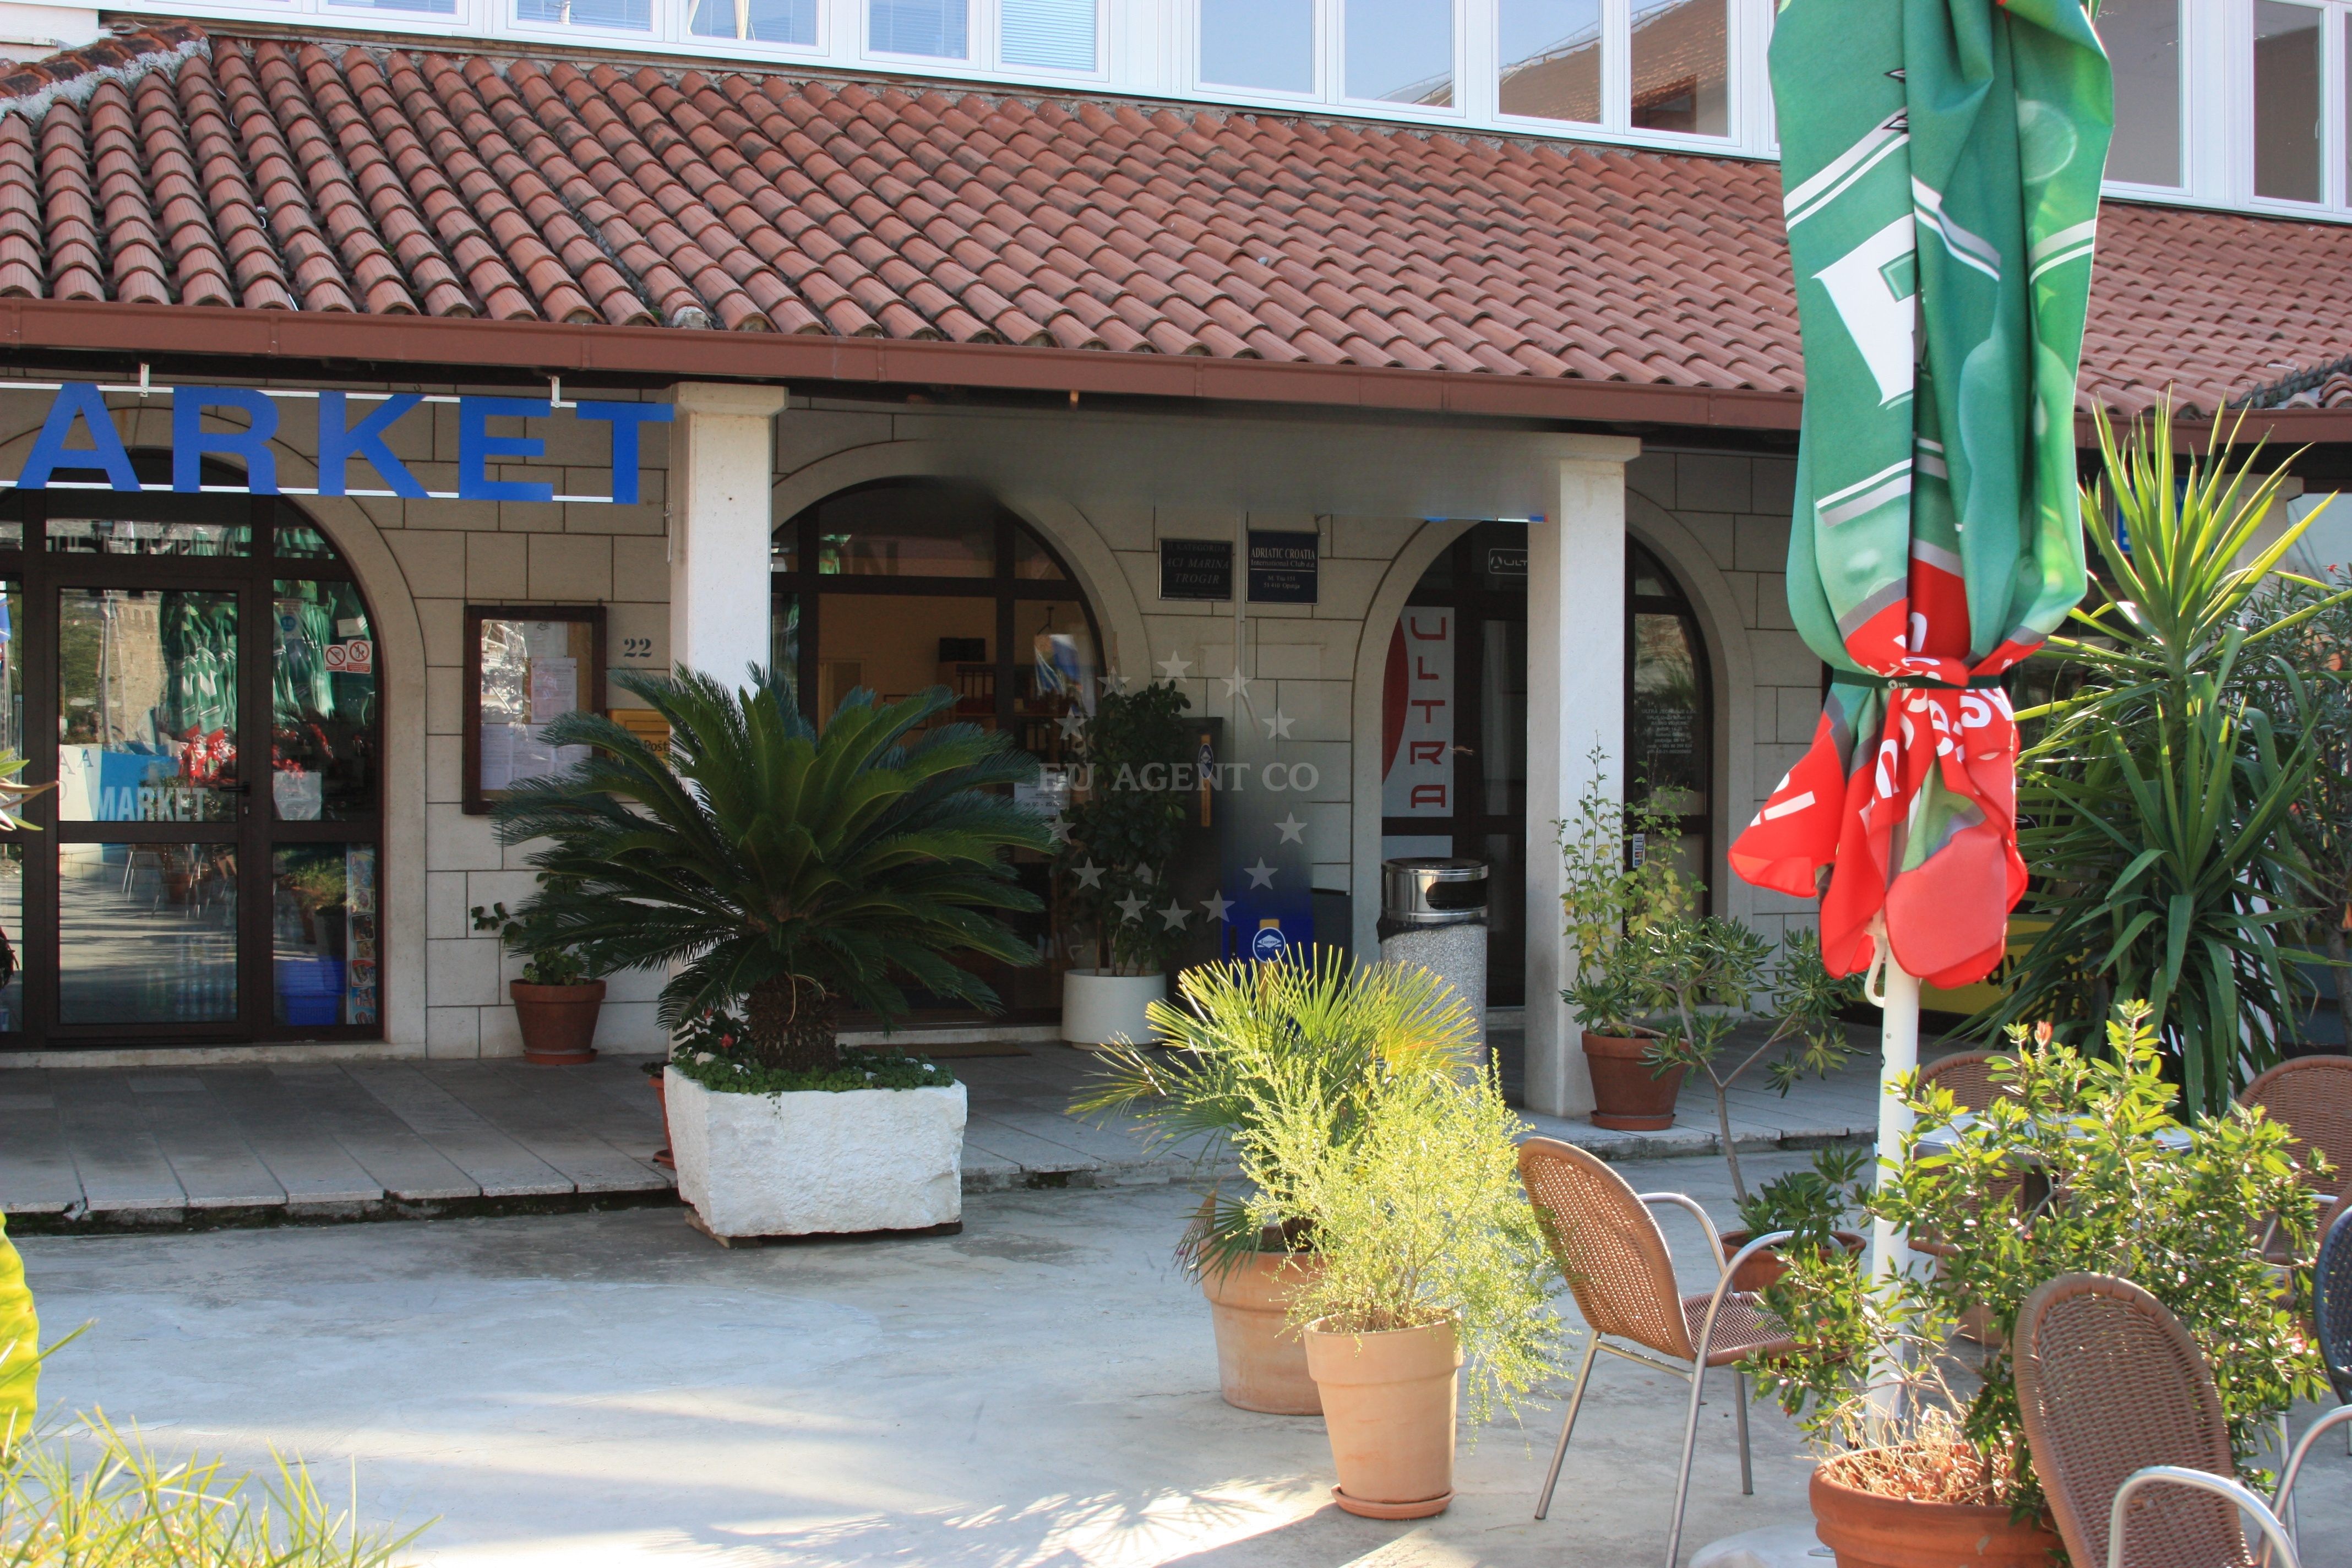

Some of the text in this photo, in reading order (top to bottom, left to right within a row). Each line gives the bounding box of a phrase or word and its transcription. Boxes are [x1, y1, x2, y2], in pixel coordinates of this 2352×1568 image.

[15, 382, 674, 504] ARKET
[1165, 558, 1229, 569] ACI MARINA
[1251, 548, 1315, 560] ADRIATIC CROATIA
[1175, 574, 1220, 584] TROGIR
[624, 638, 651, 657] 22
[1410, 617, 1446, 809] ULTRA
[98, 786, 209, 821] MARKET
